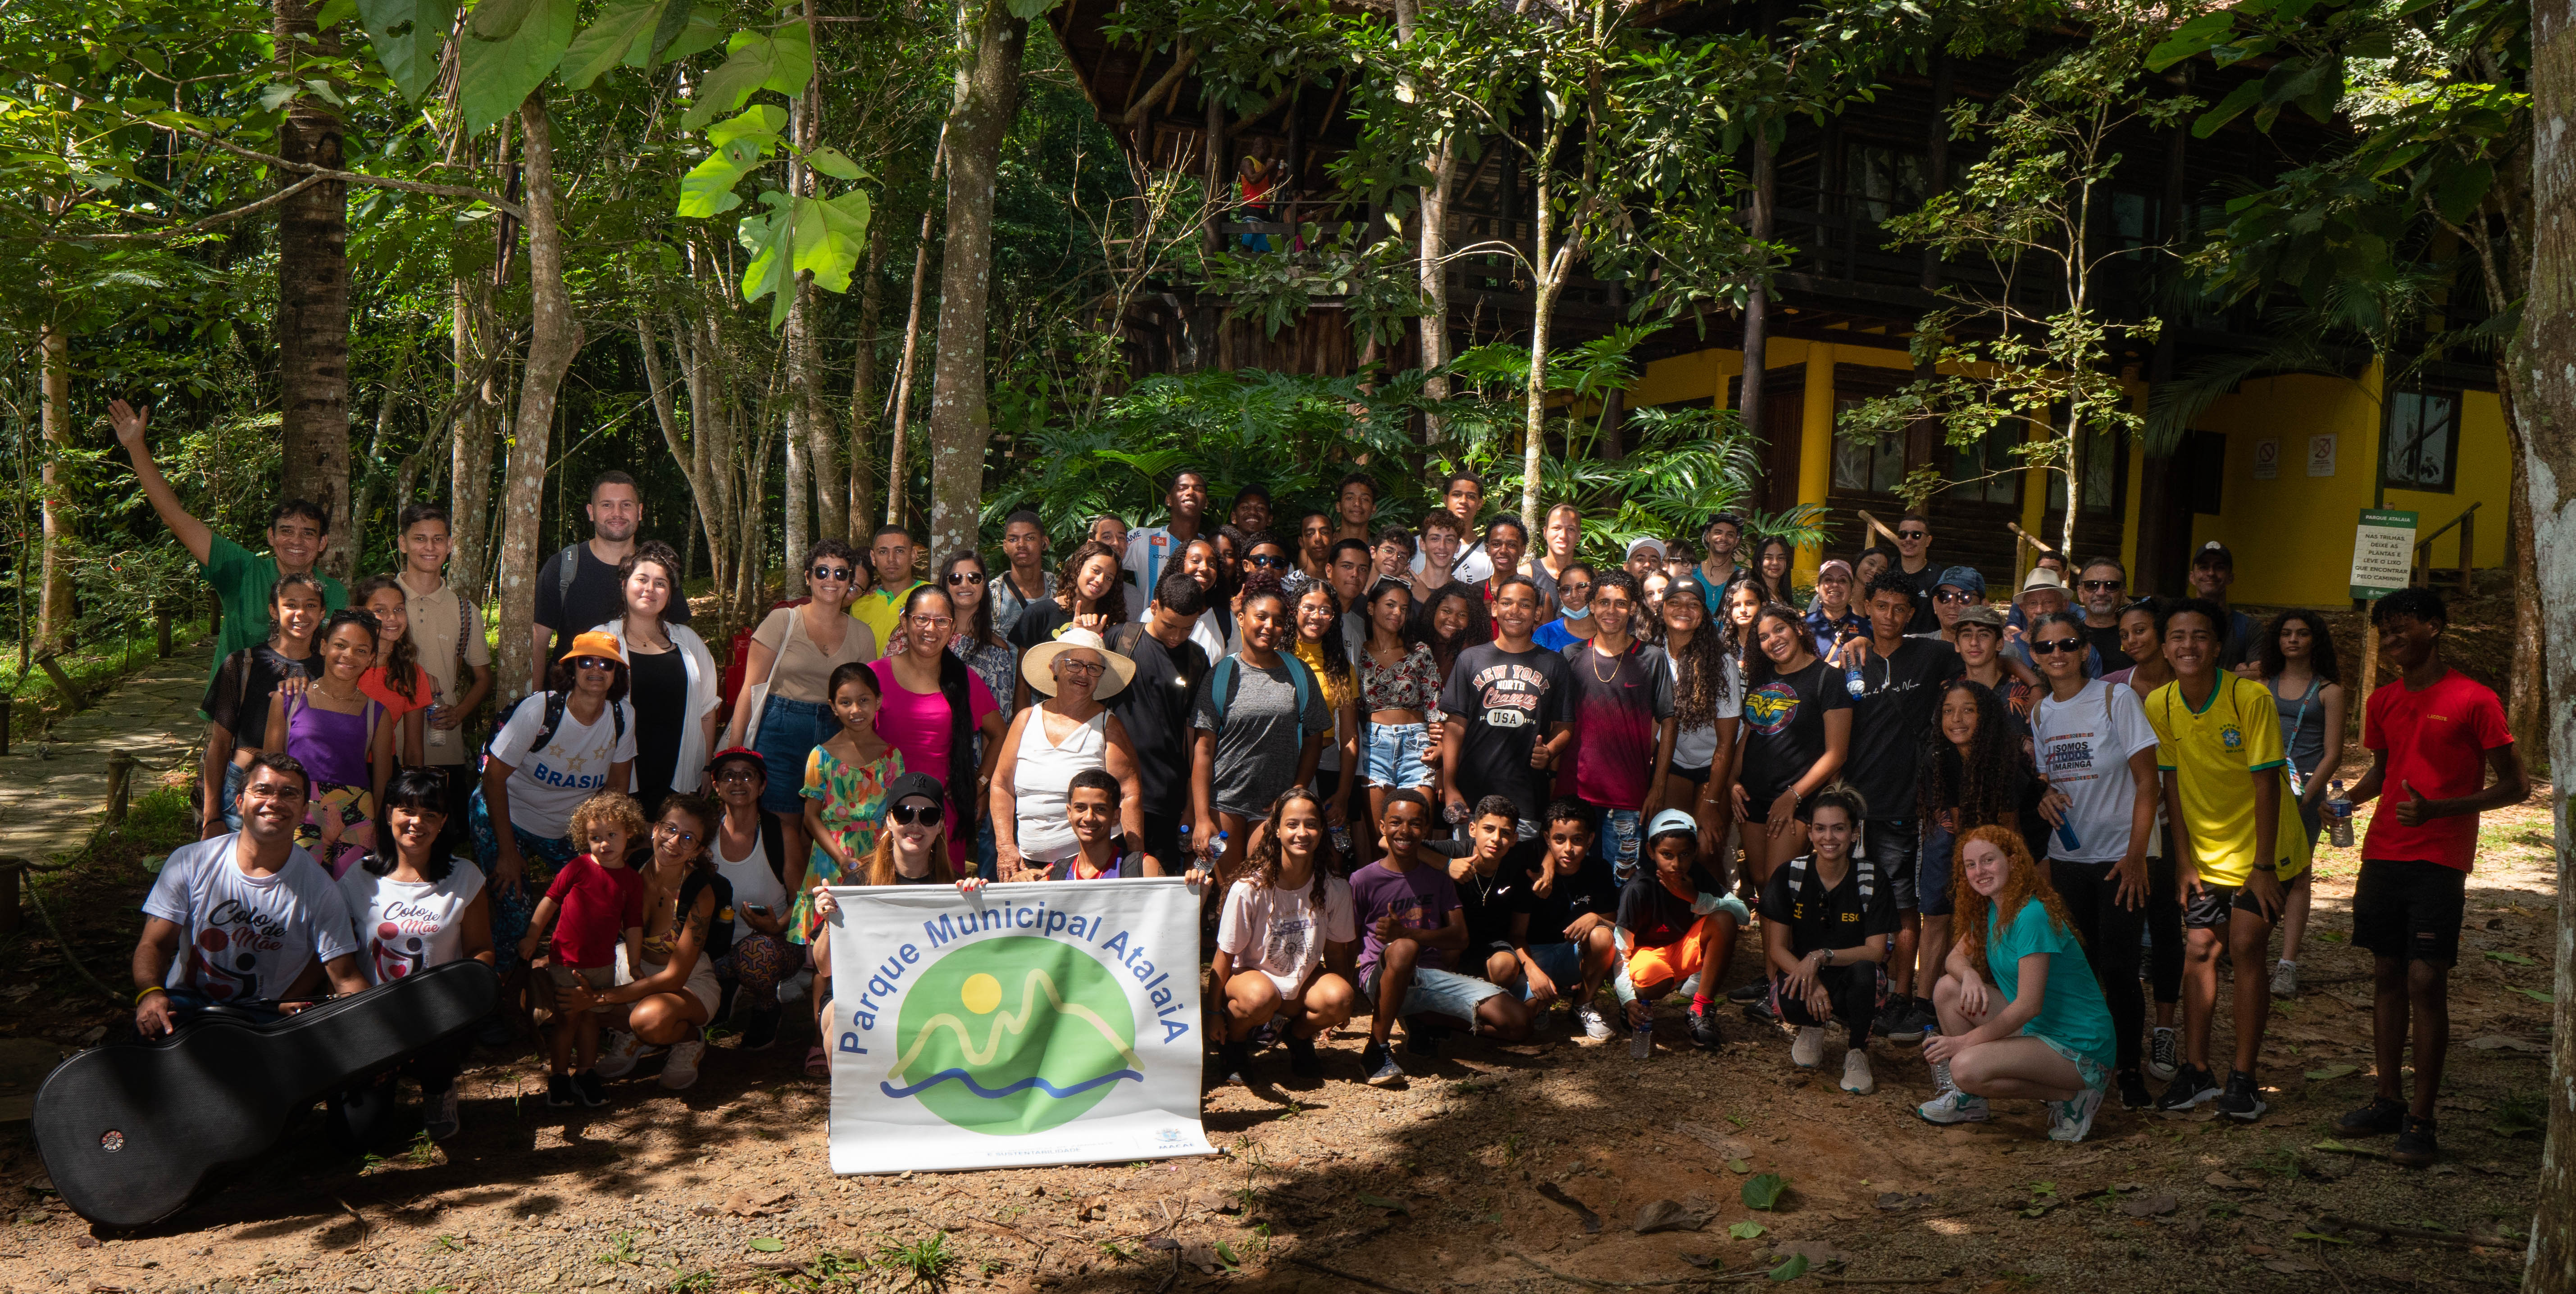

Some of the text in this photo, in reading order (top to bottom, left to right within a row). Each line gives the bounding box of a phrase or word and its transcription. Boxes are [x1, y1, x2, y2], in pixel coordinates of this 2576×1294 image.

[1472, 664, 1550, 695] NEW YORK
[1496, 680, 1526, 691] NORTH
[1482, 686, 1538, 711] Champs
[1493, 712, 1517, 724] USA
[2056, 741, 2088, 753] SOMOS
[2056, 751, 2089, 762] TODOS
[534, 763, 605, 789] BRASIL
[383, 901, 441, 922] Colo de
[1392, 894, 1434, 911] NIKE
[209, 899, 288, 937] Colo de
[401, 919, 440, 935] Mãe
[231, 926, 283, 953] Mãe
[839, 901, 1189, 1055] Parque Municipal AtalaiA
